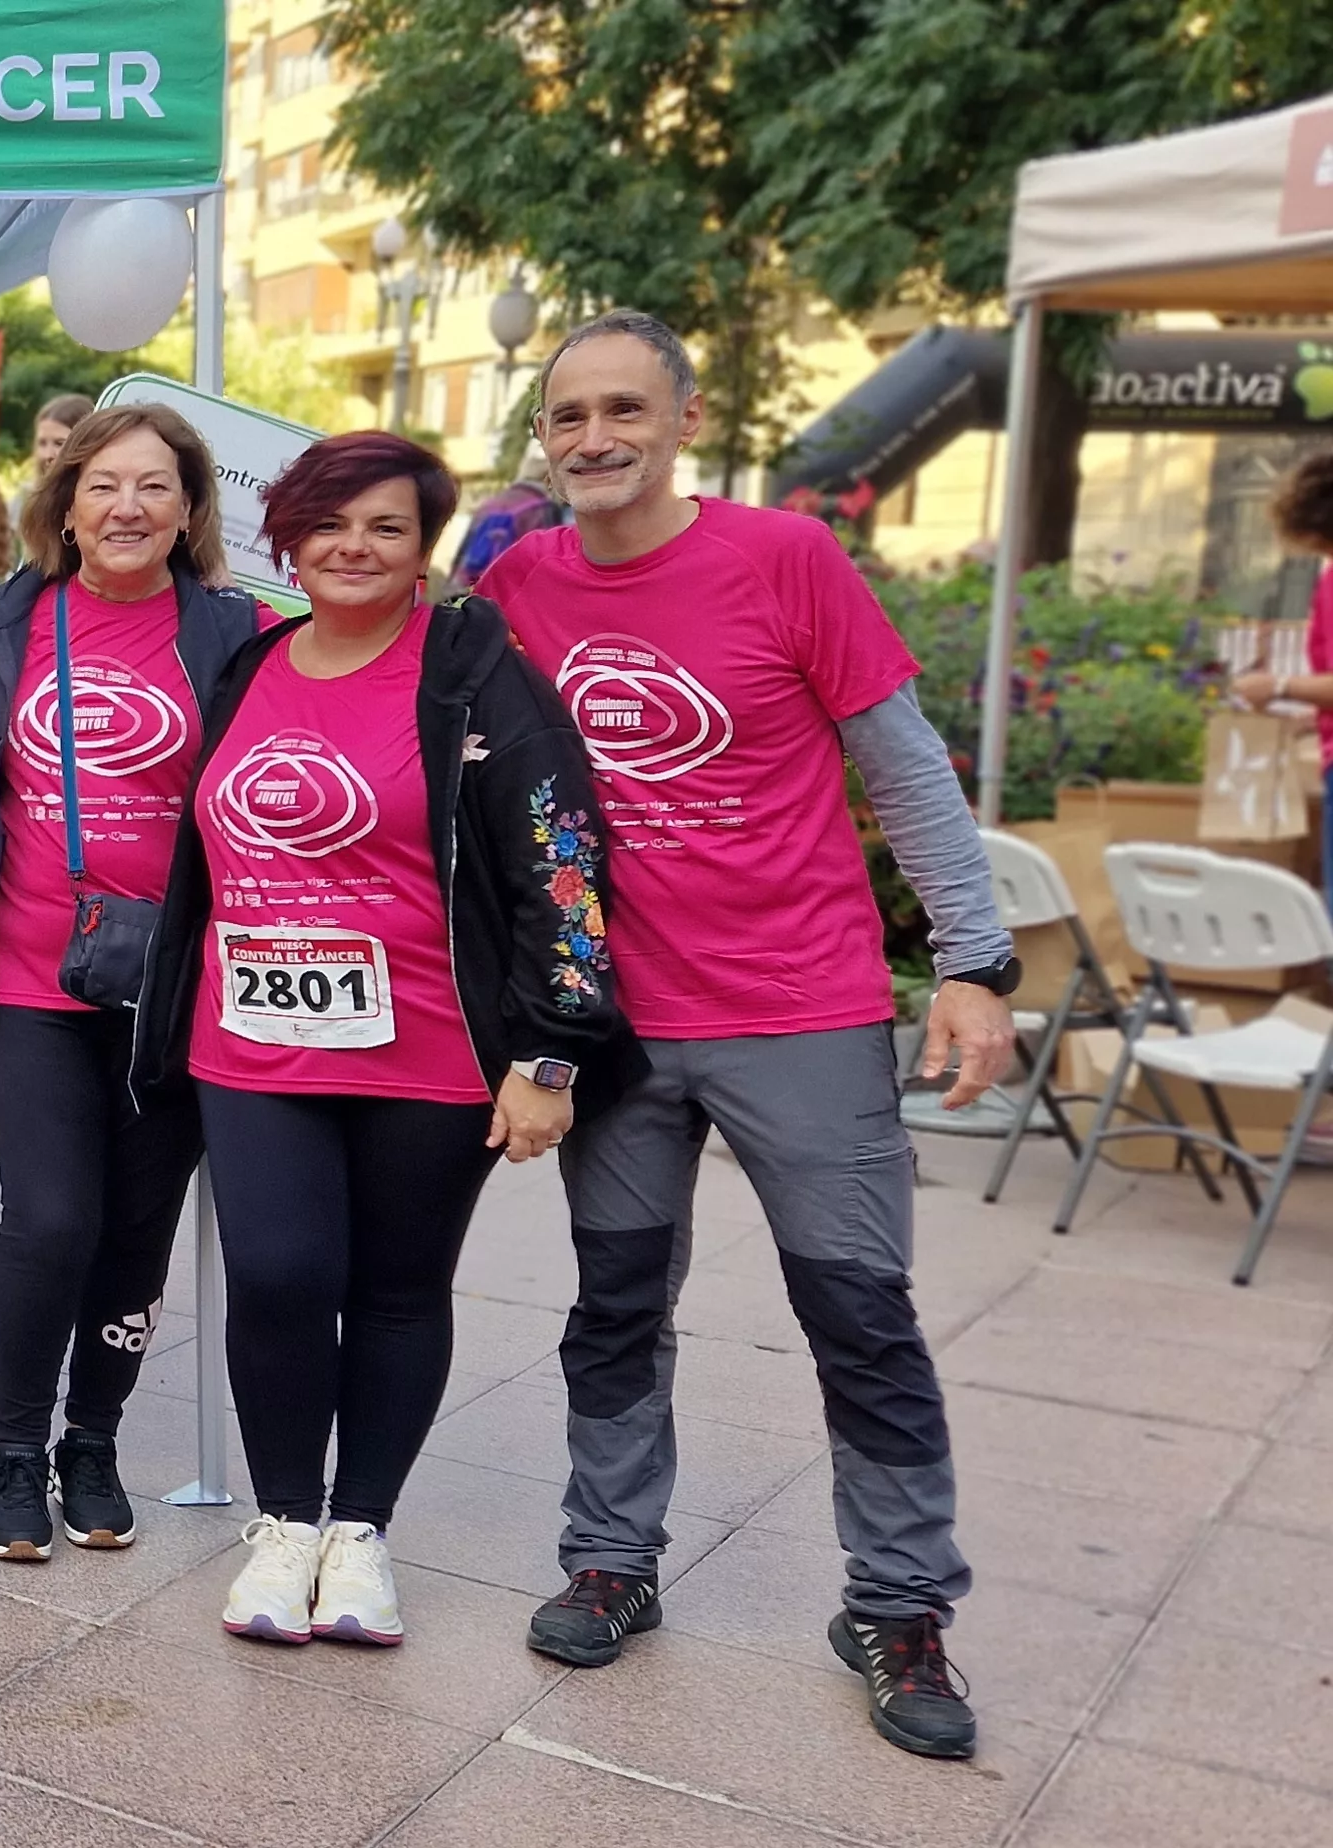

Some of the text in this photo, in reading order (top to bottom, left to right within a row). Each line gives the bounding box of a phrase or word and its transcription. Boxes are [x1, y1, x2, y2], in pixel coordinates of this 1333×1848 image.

[215, 463, 271, 493] ontra
[73, 717, 110, 731] UNTOS
[589, 711, 641, 727] JUNTOS
[272, 941, 314, 950] HUESCA
[233, 948, 366, 963] CONTRA EL CÁNCER
[235, 966, 367, 1013] 2801
